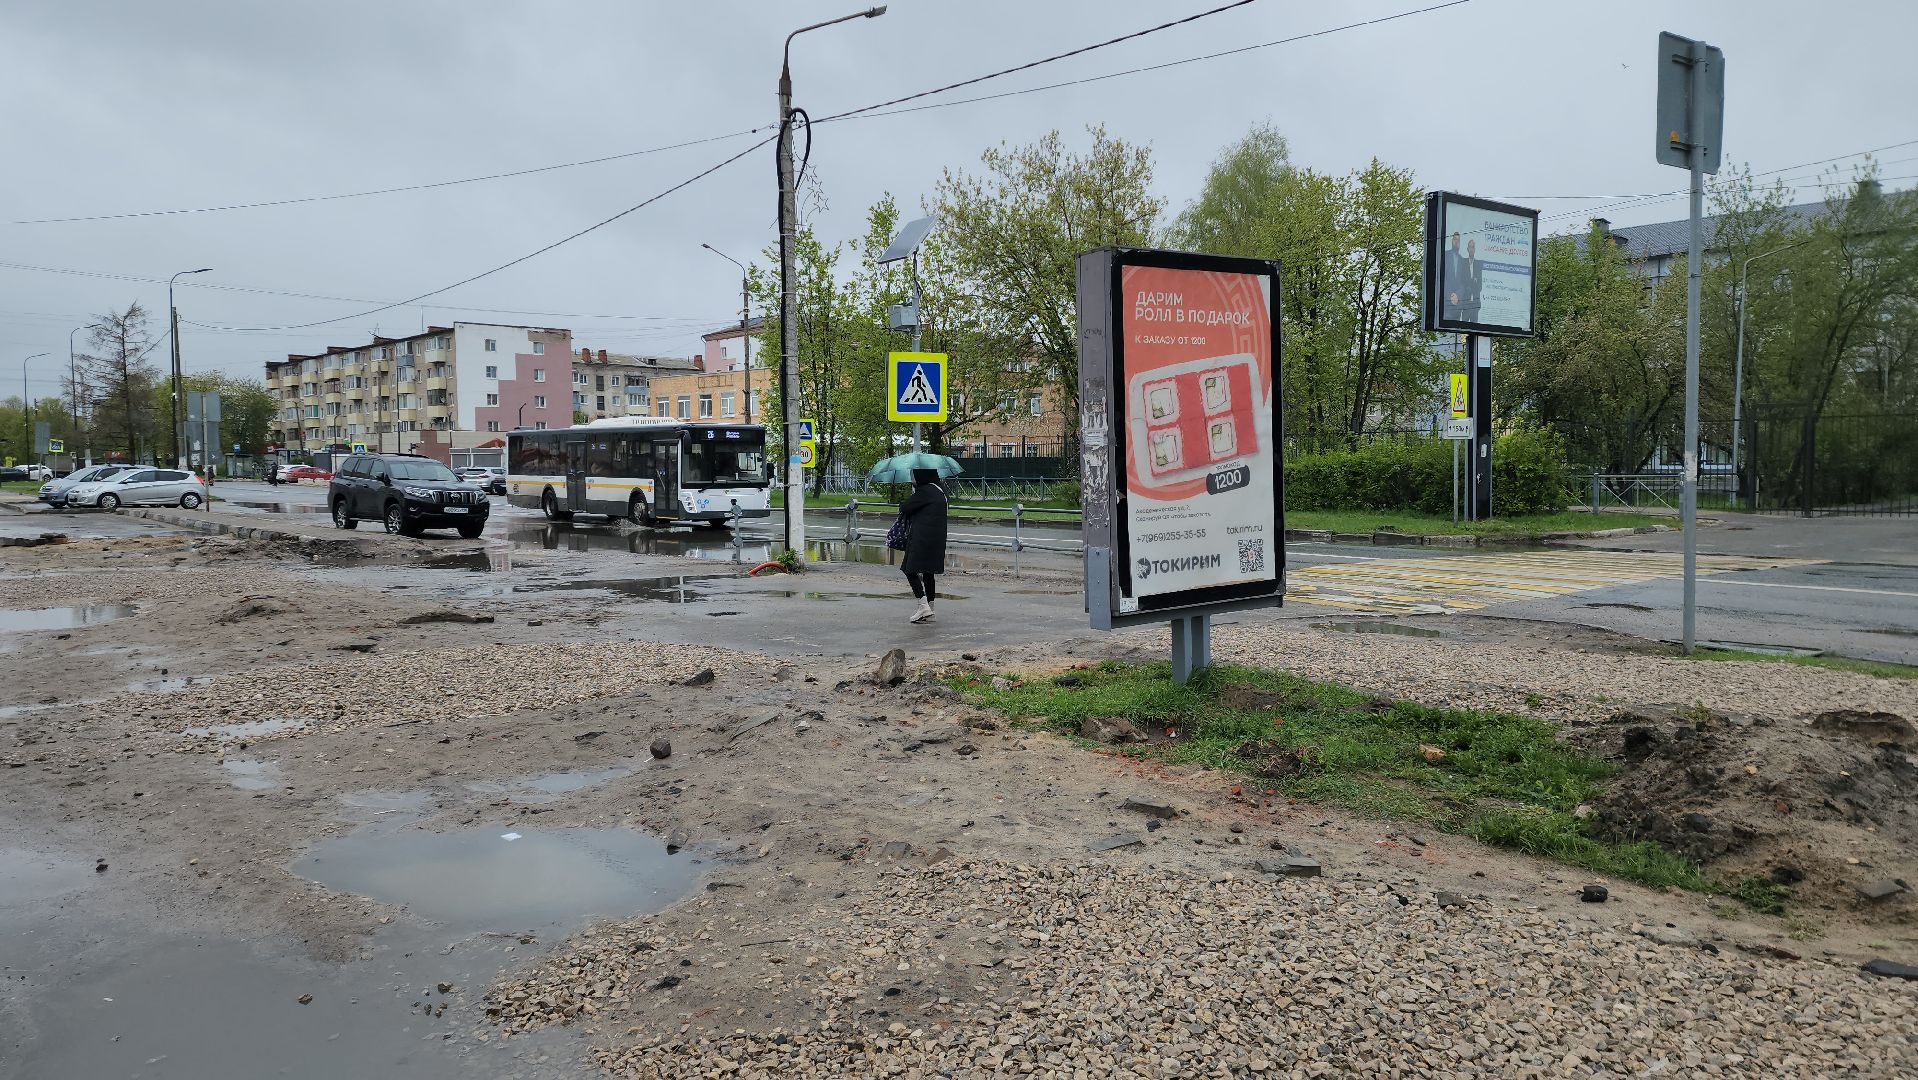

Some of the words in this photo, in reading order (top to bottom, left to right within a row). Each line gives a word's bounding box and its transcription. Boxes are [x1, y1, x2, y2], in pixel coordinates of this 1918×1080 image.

[1135, 291, 1183, 306] ДАРИМ
[1135, 307, 1172, 322] РОЛЛ
[1176, 308, 1185, 323] В
[1188, 309, 1250, 326] ПОДАРОК
[1135, 335, 1141, 344] К
[1143, 335, 1176, 345] ЗАКАЗУ
[1177, 336, 1190, 345] ОТ
[800, 450, 809, 458] 30
[1214, 469, 1242, 490] 1200
[1136, 528, 1207, 543] +7(969)255-35-55
[1152, 553, 1221, 575] ТОКИРИМ
